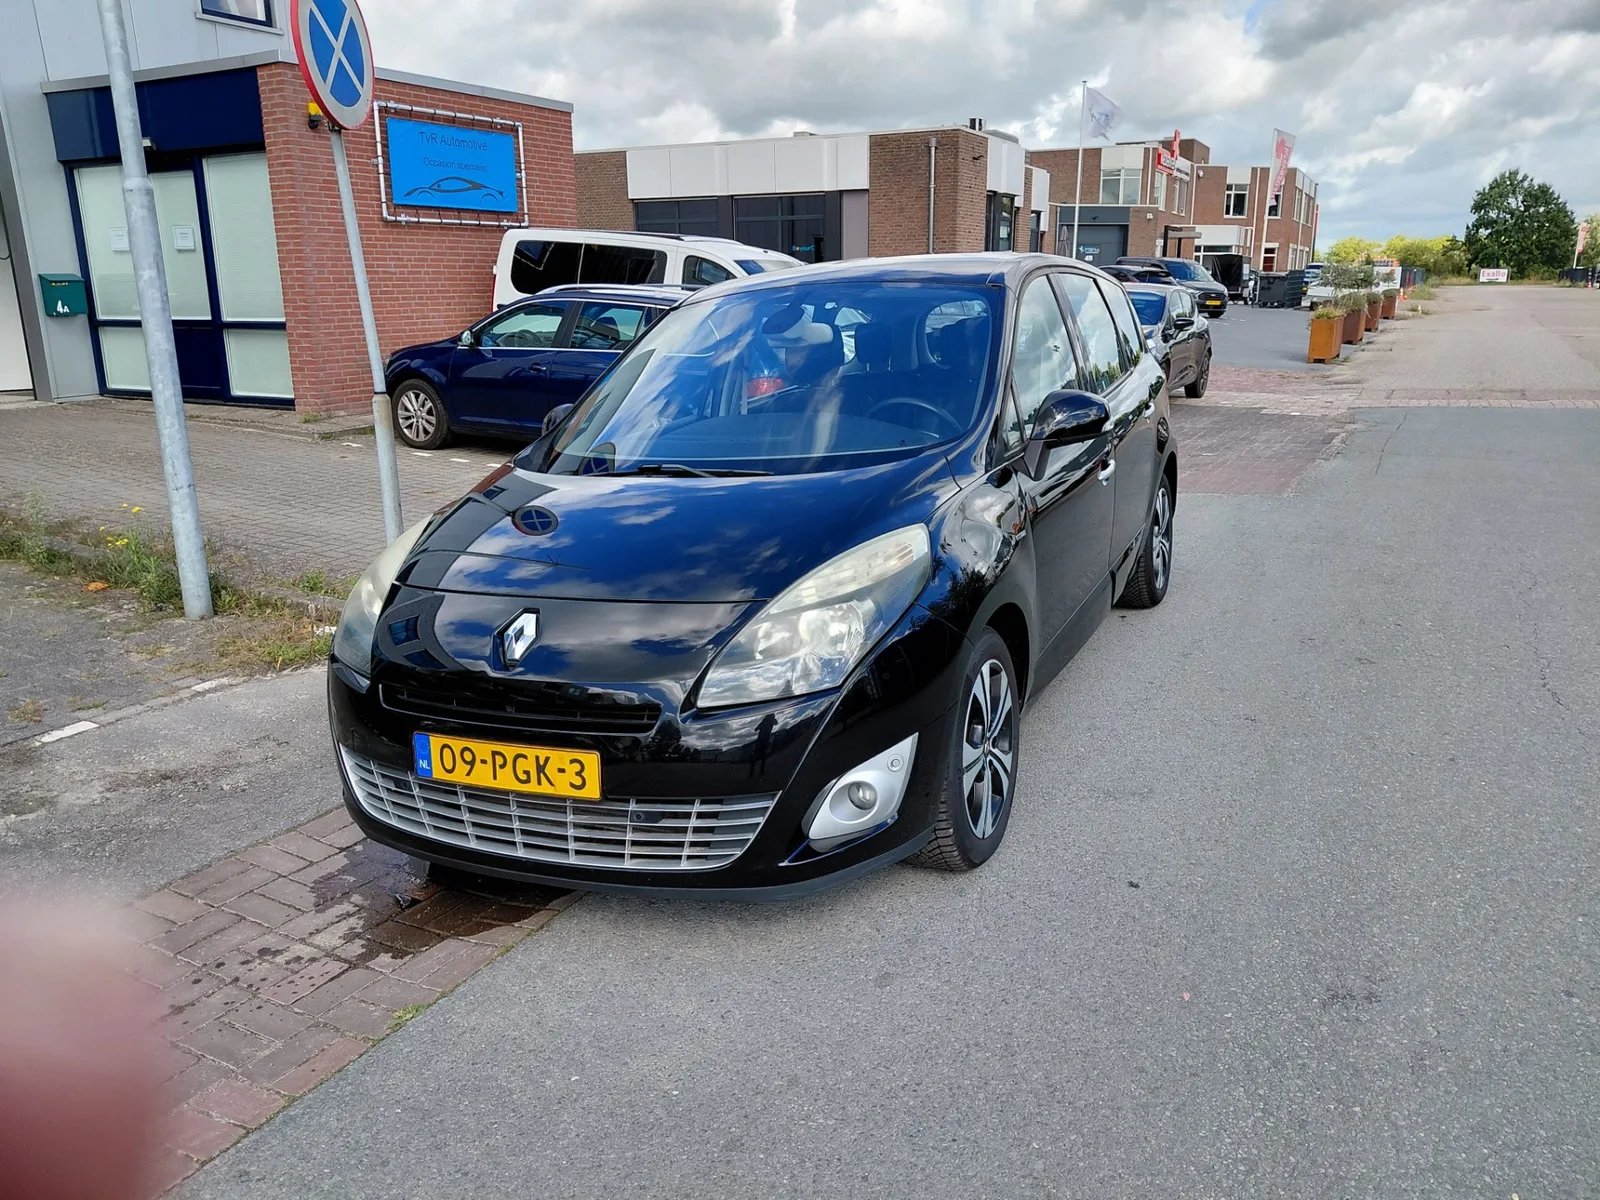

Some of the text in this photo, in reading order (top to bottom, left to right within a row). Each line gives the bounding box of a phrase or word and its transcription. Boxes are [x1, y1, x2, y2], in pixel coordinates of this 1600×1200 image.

[419, 131, 488, 151] TvR Automotive
[423, 156, 488, 173] Occasion specialist
[419, 743, 587, 791] NL 09-PGK-3
